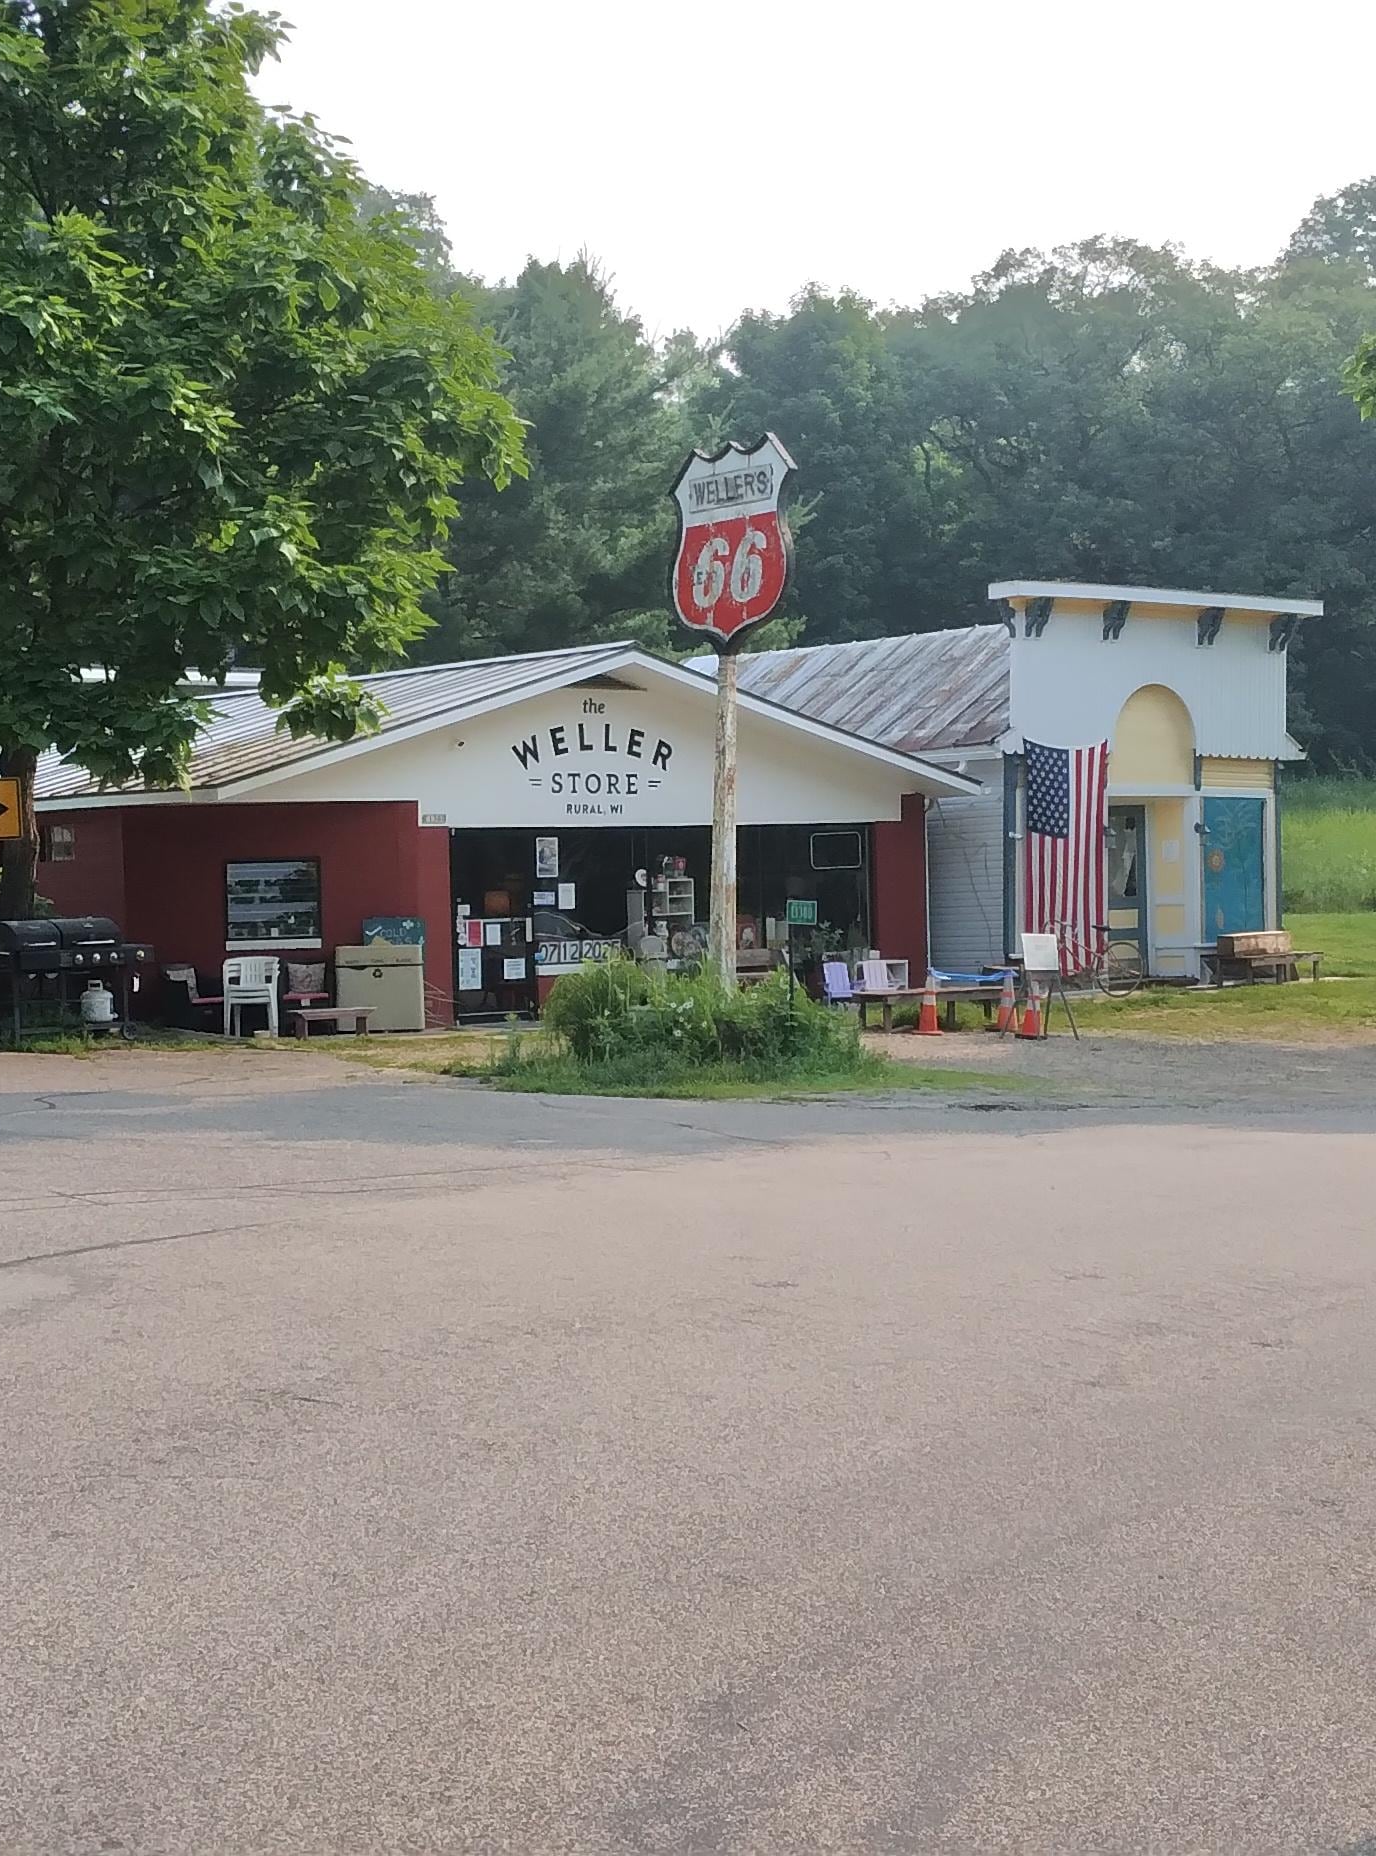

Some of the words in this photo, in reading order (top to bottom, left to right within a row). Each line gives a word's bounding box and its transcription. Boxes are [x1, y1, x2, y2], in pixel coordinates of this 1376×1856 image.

[693, 471, 768, 505] WELLER'S
[693, 531, 766, 608] 66
[582, 698, 606, 714] the
[511, 723, 673, 772] WELLER
[551, 773, 638, 795] STORE
[566, 804, 606, 815] RURAL,
[610, 804, 623, 815] WI
[539, 944, 557, 961] 07
[562, 943, 579, 960] 12
